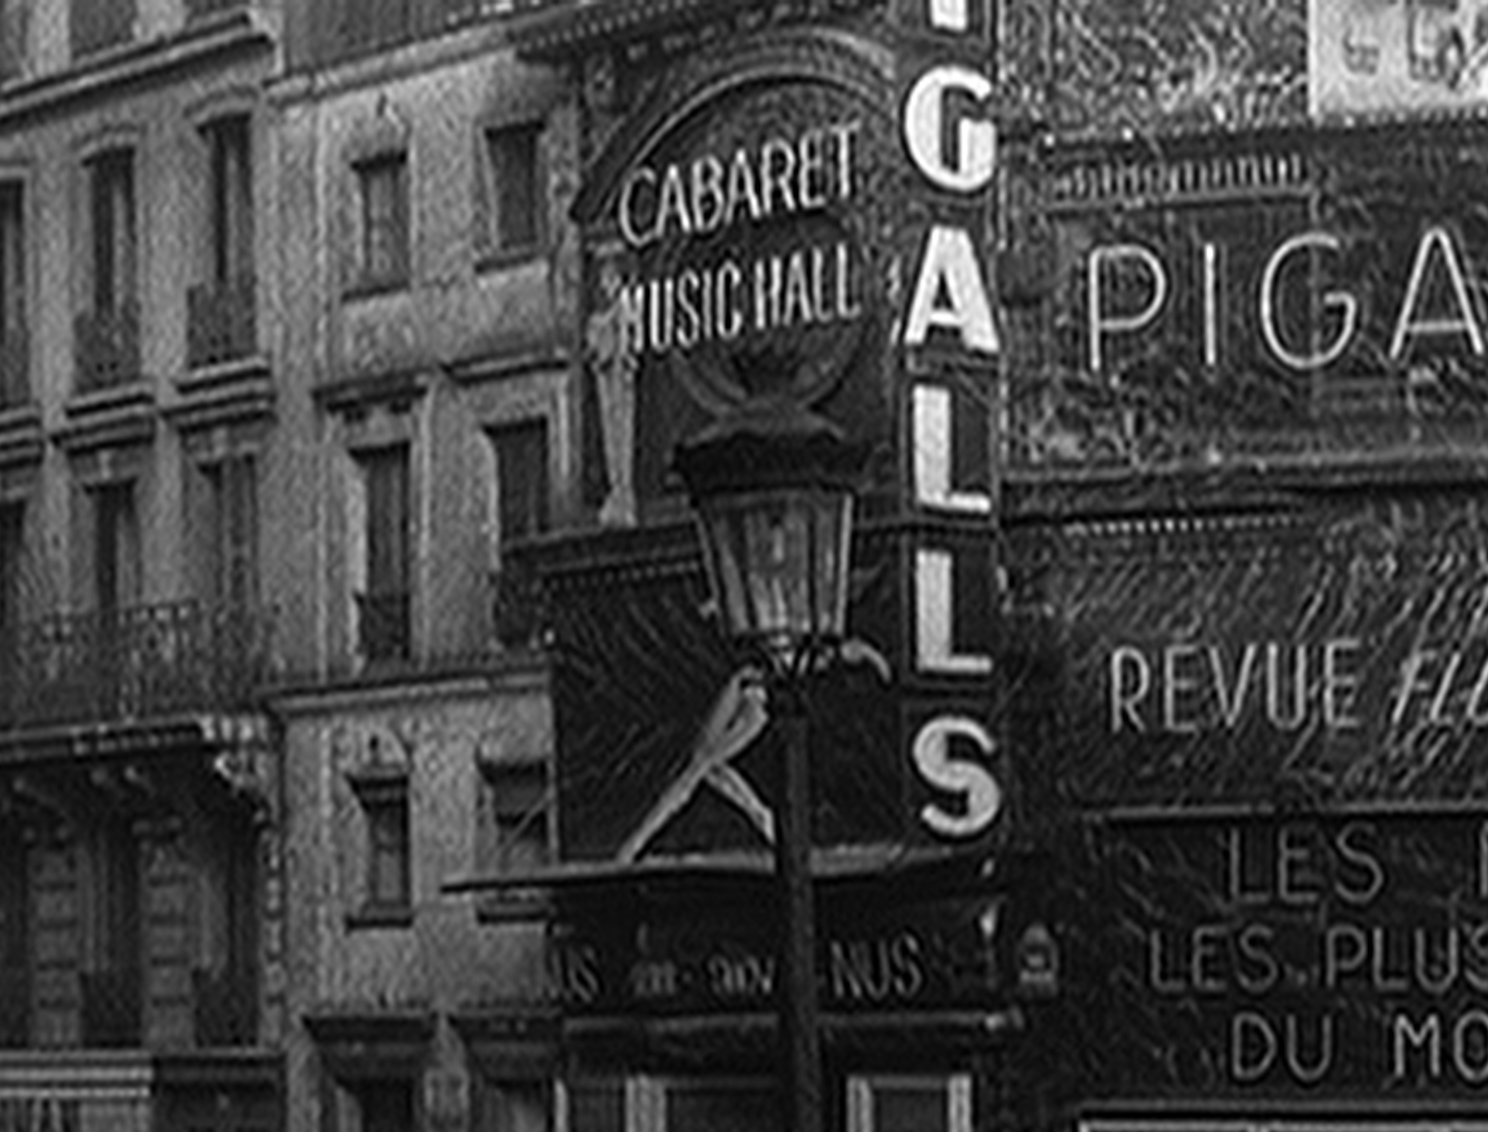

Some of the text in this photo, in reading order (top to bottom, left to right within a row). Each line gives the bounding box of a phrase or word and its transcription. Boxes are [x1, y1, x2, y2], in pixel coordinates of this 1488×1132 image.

[618, 120, 862, 248] CABARET
[614, 241, 862, 355] MUSIC HALL
[1108, 636, 1364, 734] REVUE
[1228, 822, 1386, 907] LES
[829, 935, 924, 1002] NUS
[1148, 925, 1278, 994] LES
[1230, 1013, 1334, 1082] DU
